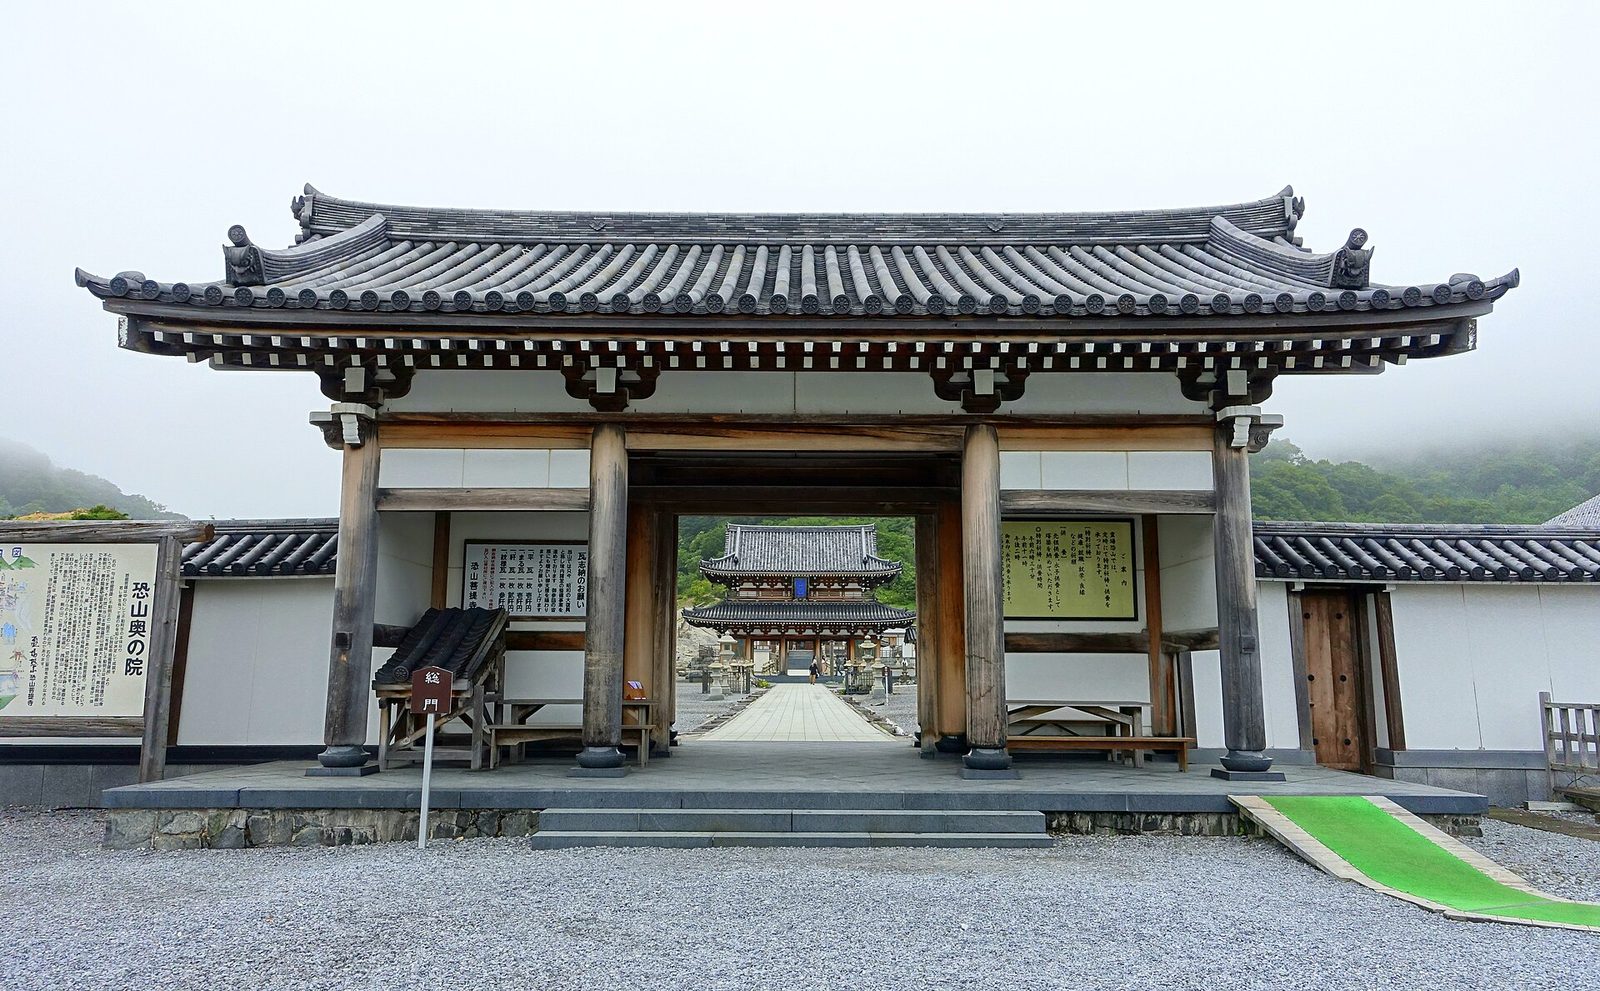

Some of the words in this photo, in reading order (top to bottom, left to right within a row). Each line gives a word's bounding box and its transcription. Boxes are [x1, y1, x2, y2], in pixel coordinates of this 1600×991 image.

[469, 562, 479, 609] 恐山菩提寺
[577, 552, 587, 609] 瓦志納のお願い
[124, 582, 151, 676] 恐山奥の院
[423, 671, 440, 712] 総門
